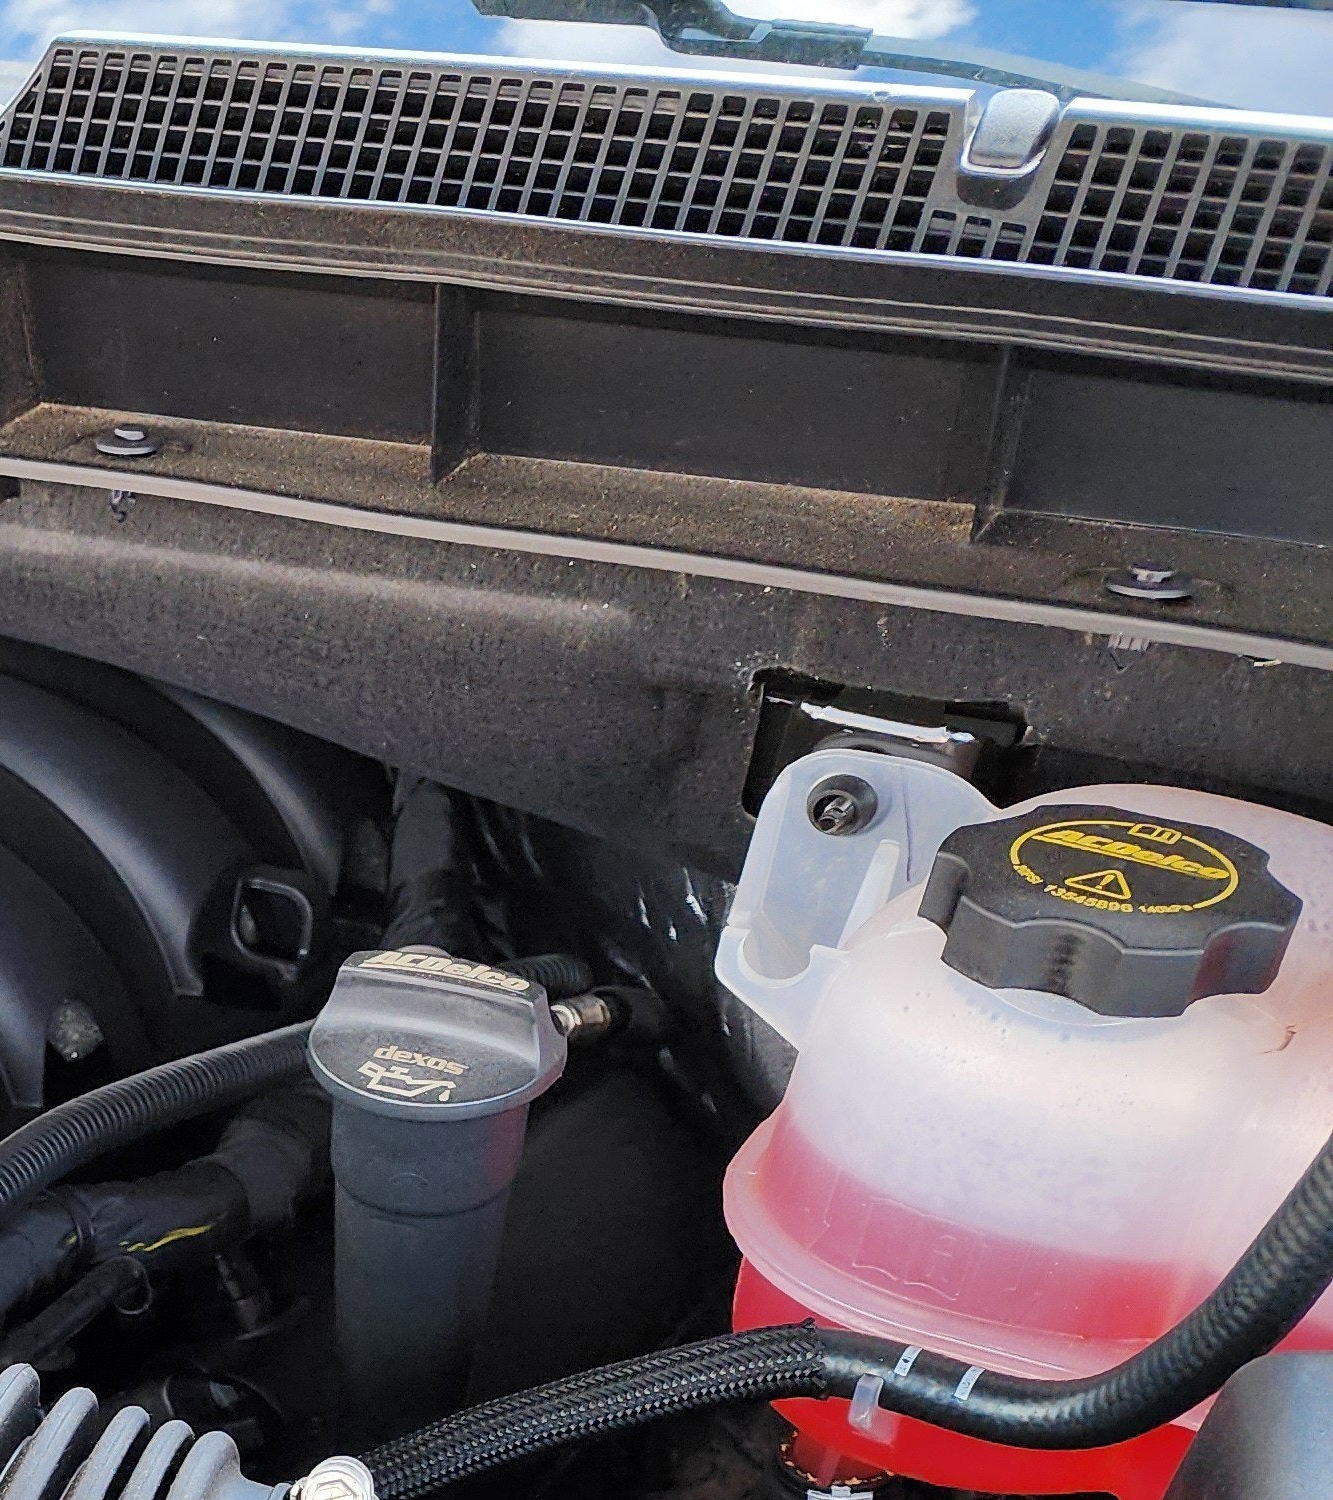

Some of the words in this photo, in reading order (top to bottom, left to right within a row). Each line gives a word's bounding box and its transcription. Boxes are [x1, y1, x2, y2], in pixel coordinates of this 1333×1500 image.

[1035, 829, 1230, 880] ACDelco
[361, 950, 531, 992] ACDelco
[373, 1044, 470, 1076] dexos
